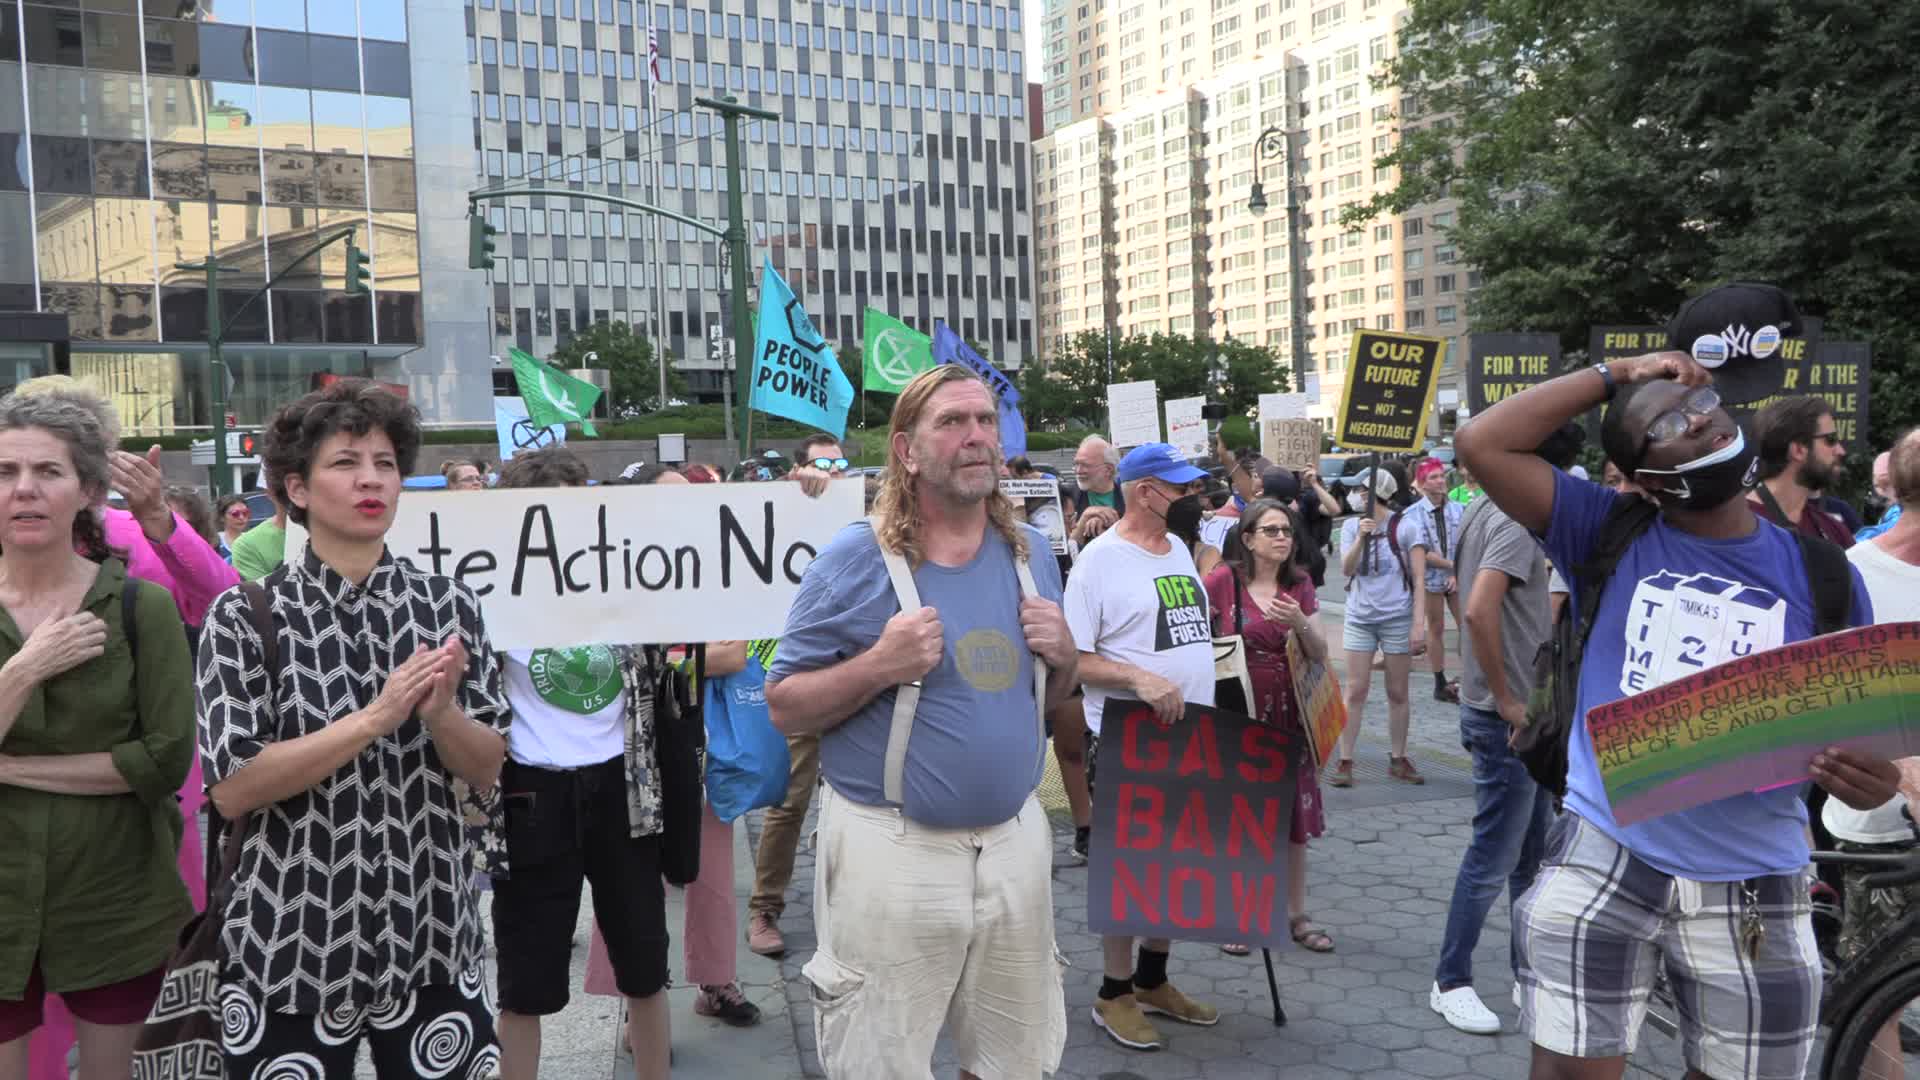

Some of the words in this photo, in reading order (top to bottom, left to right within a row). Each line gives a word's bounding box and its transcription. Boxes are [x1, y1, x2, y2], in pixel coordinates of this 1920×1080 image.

[1370, 341, 1424, 363] OUR
[1605, 333, 1639, 349] FOR
[1645, 333, 1667, 349] TH
[1781, 339, 1807, 360] HE
[763, 339, 832, 387] PEOPLE
[1364, 365, 1422, 387] FUTURE
[1483, 355, 1514, 376] FOR
[1518, 355, 1549, 376] THE
[1826, 364, 1859, 385] THE
[757, 366, 829, 412] POWER
[1383, 389, 1394, 399] IS
[1375, 403, 1396, 416] NOT
[1348, 421, 1413, 440] NEGOTIABLE
[400, 511, 498, 597] te
[511, 503, 701, 597] Action
[719, 501, 817, 589] No
[1156, 575, 1196, 608] OFF
[1165, 606, 1205, 627] FOSSIL
[1169, 622, 1210, 646] FUELS
[1628, 599, 1662, 691] TIME
[1678, 636, 1707, 667] 2
[531, 652, 554, 696] FRIDA
[1589, 700, 1629, 725] WE
[1631, 678, 1697, 713] MUST
[1856, 627, 1888, 647] TO
[583, 694, 607, 710] U.S.
[1593, 715, 1639, 741] FOR
[1643, 698, 1692, 725] OUR
[1700, 664, 1791, 706] FUTURE
[1807, 646, 1886, 674] THAT'S
[1700, 686, 1777, 722] GREEN
[1121, 708, 1289, 783] GAS
[1602, 743, 1642, 771] ALL
[1649, 735, 1677, 753] OF
[1688, 721, 1720, 742] US
[1729, 705, 1777, 732] AND
[1785, 690, 1834, 715] GET
[1115, 783, 1280, 865] BAN
[1111, 858, 1277, 936] NOW
